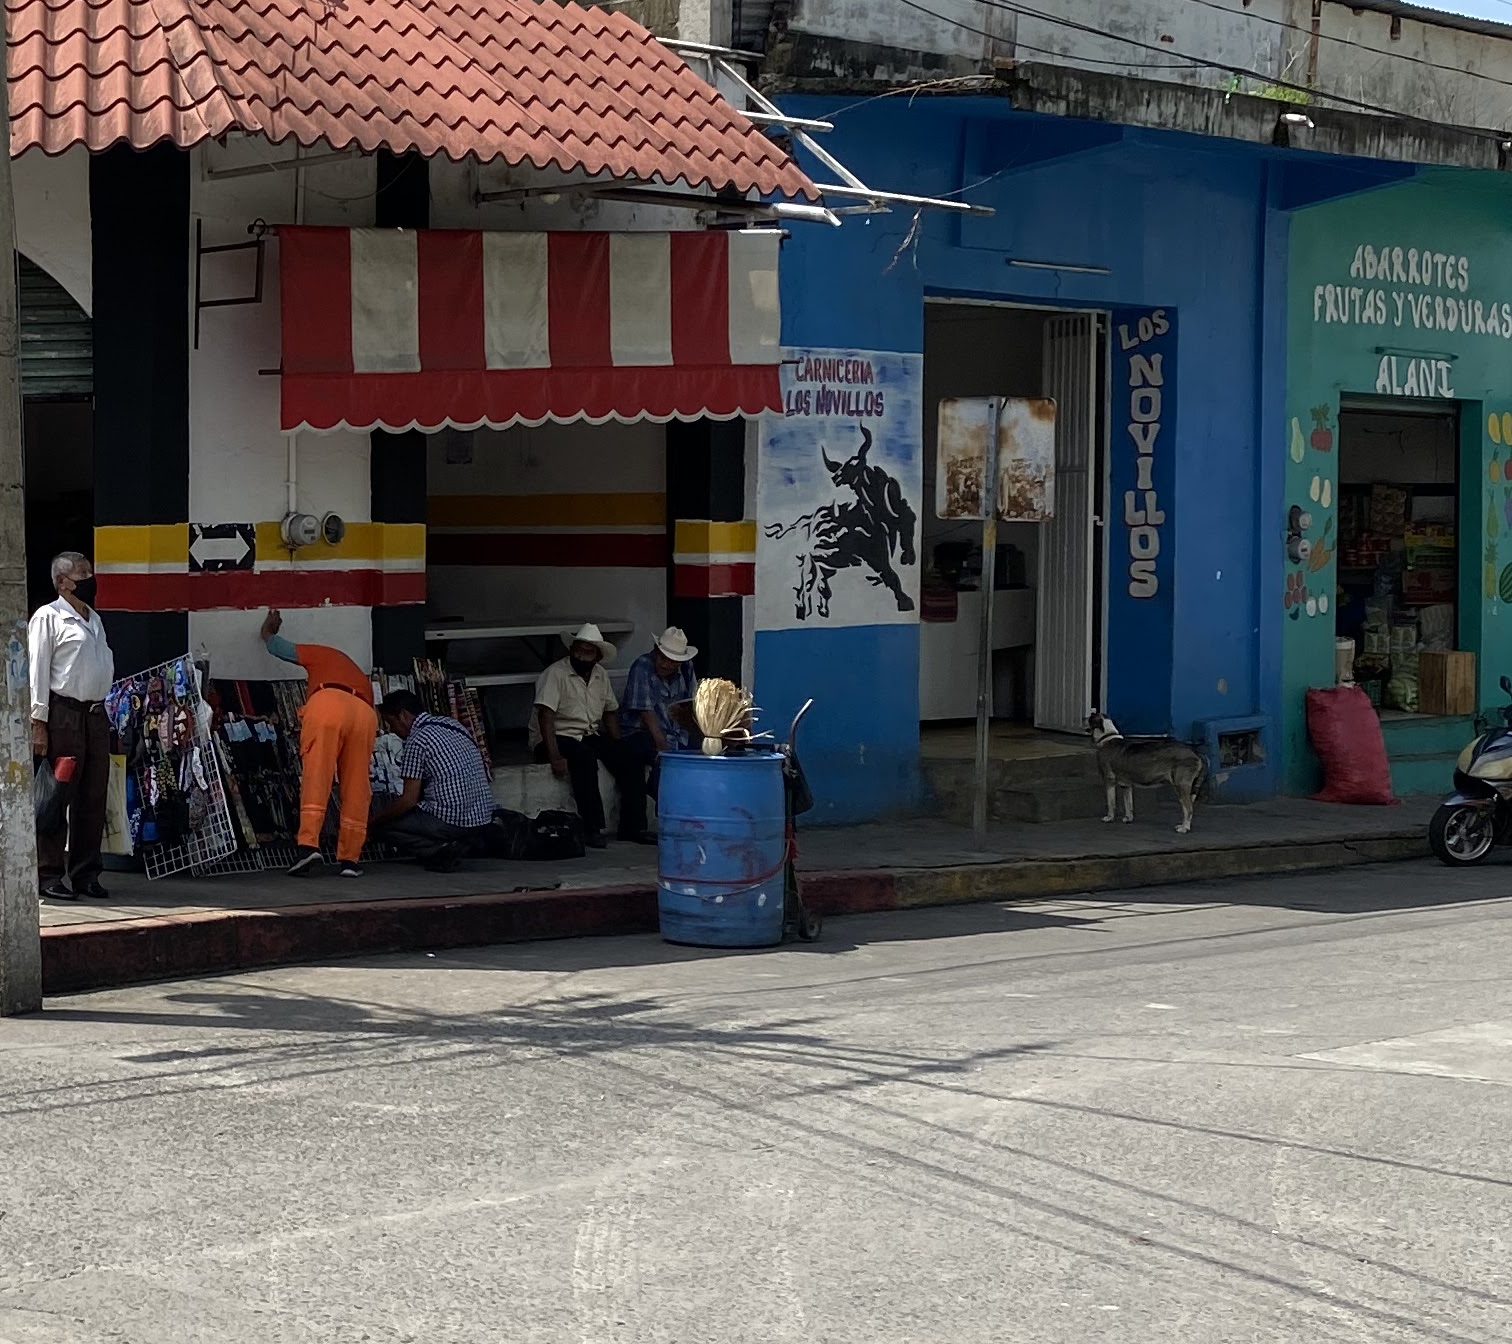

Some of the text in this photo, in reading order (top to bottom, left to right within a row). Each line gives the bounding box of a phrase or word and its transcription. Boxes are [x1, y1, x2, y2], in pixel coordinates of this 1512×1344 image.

[1350, 244, 1469, 293] ABARROTES
[1118, 309, 1170, 350] LOS
[1314, 283, 1512, 339] FRUTAS Y VERDURAS
[795, 356, 874, 385] CARNICERIA
[1376, 355, 1455, 398] ALANI
[786, 389, 811, 417] LOS
[1124, 353, 1165, 598] NOVILLOS
